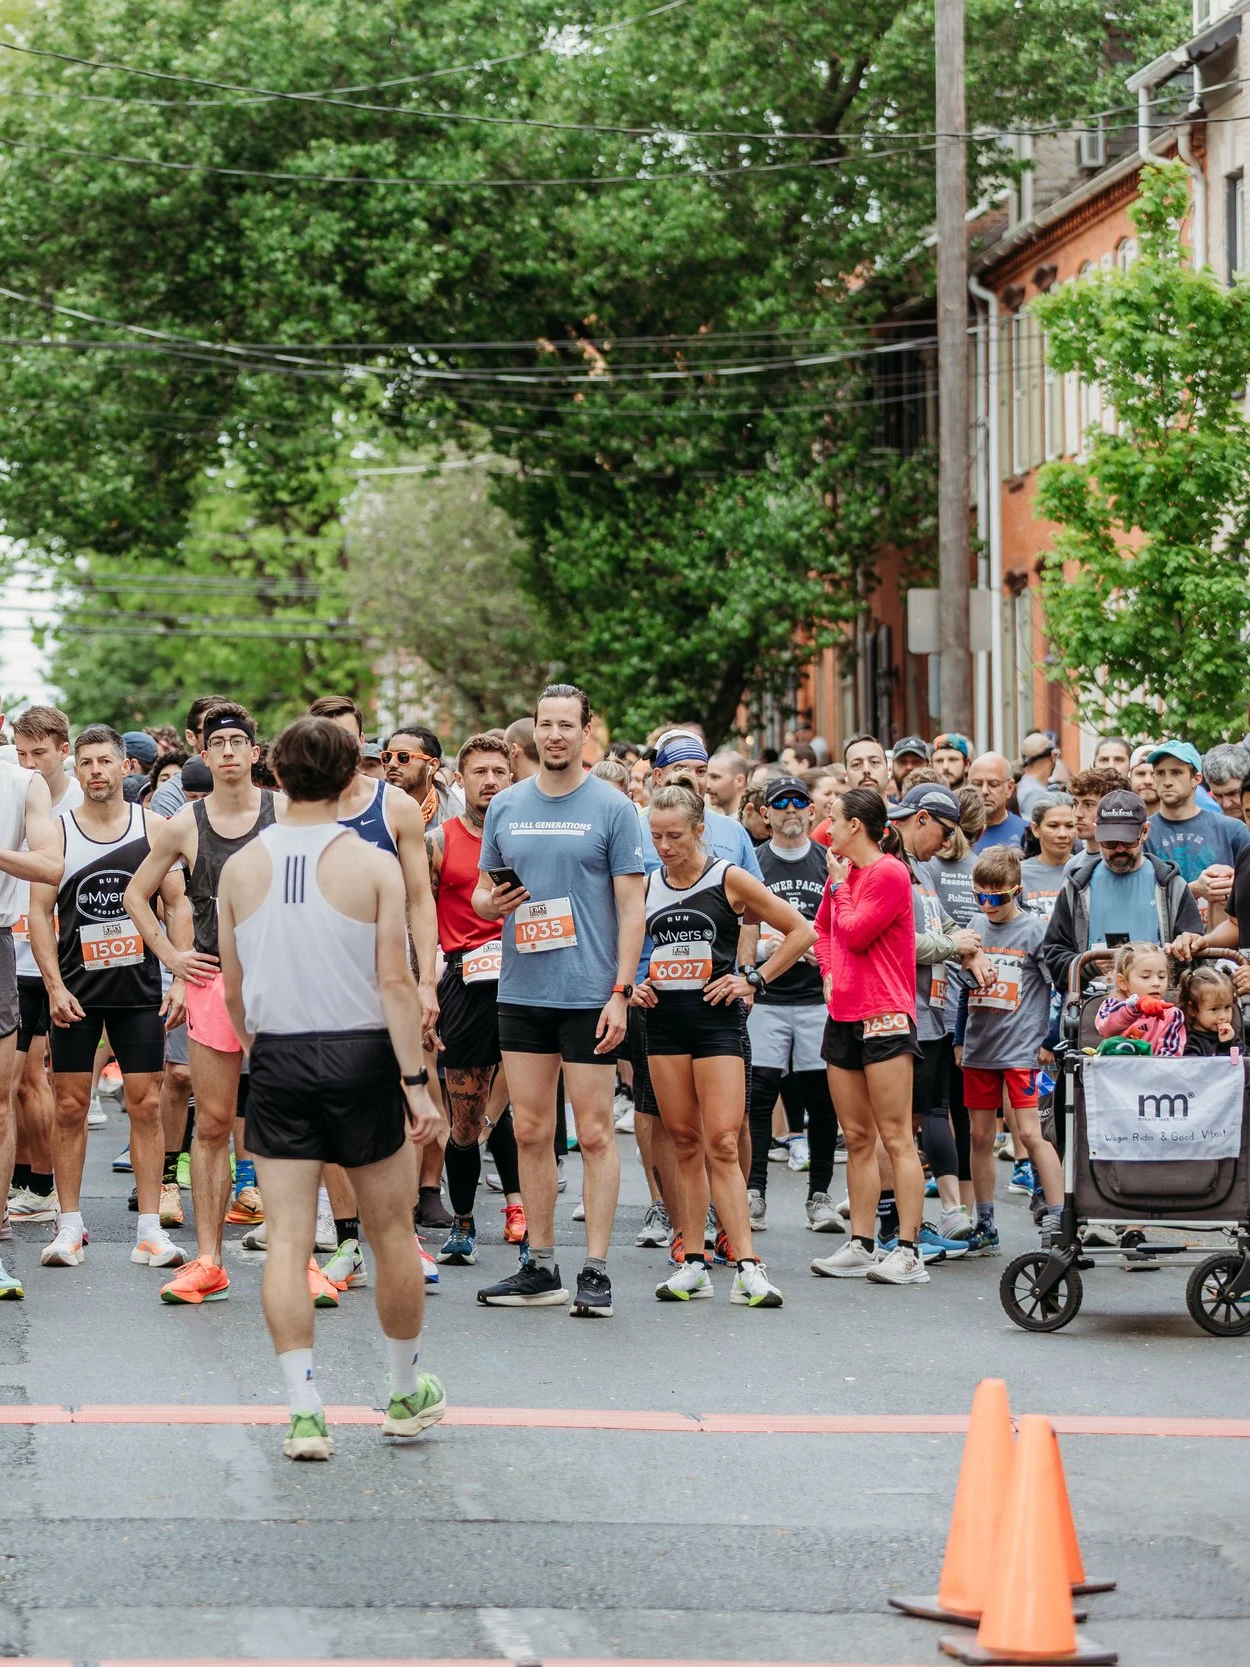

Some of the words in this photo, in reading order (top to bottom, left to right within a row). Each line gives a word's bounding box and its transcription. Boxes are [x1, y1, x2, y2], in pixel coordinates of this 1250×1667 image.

[535, 822, 592, 831] GENERATIONS
[766, 880, 793, 894] OWER
[88, 891, 125, 906] Myer
[93, 907, 124, 915] PROJECT
[667, 915, 689, 923] RUN
[521, 919, 564, 941] 1935
[658, 929, 702, 943] Myers
[90, 938, 137, 958] 1502
[656, 962, 704, 979] 6027
[863, 1013, 908, 1033] 1650
[1105, 1133, 1129, 1143] Wagon
[1160, 1131, 1168, 1141] &
[1171, 1131, 1195, 1141] Good
